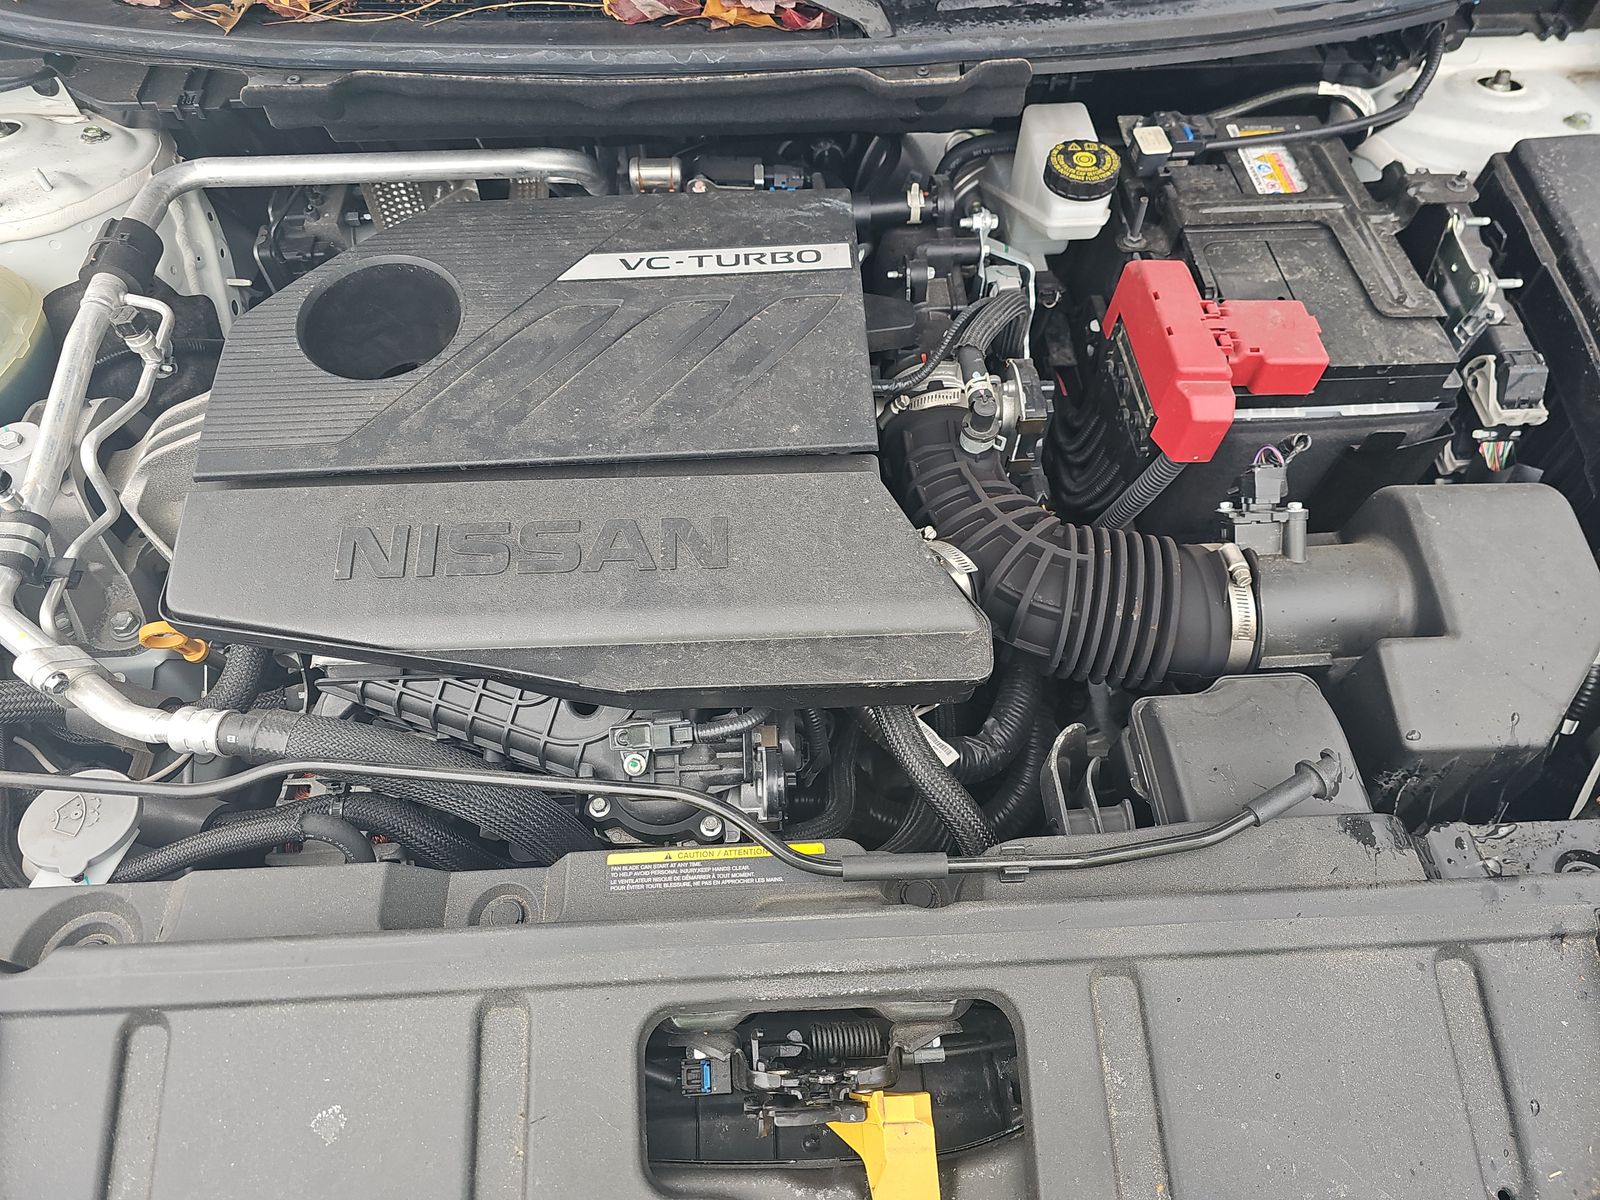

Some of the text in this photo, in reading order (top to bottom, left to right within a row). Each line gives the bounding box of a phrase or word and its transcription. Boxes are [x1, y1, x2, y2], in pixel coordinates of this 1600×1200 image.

[619, 250, 822, 271] VC-TURBO
[334, 516, 729, 580] NISSAN
[678, 850, 714, 859] CAUTION
[724, 848, 768, 857] ATTENTION
